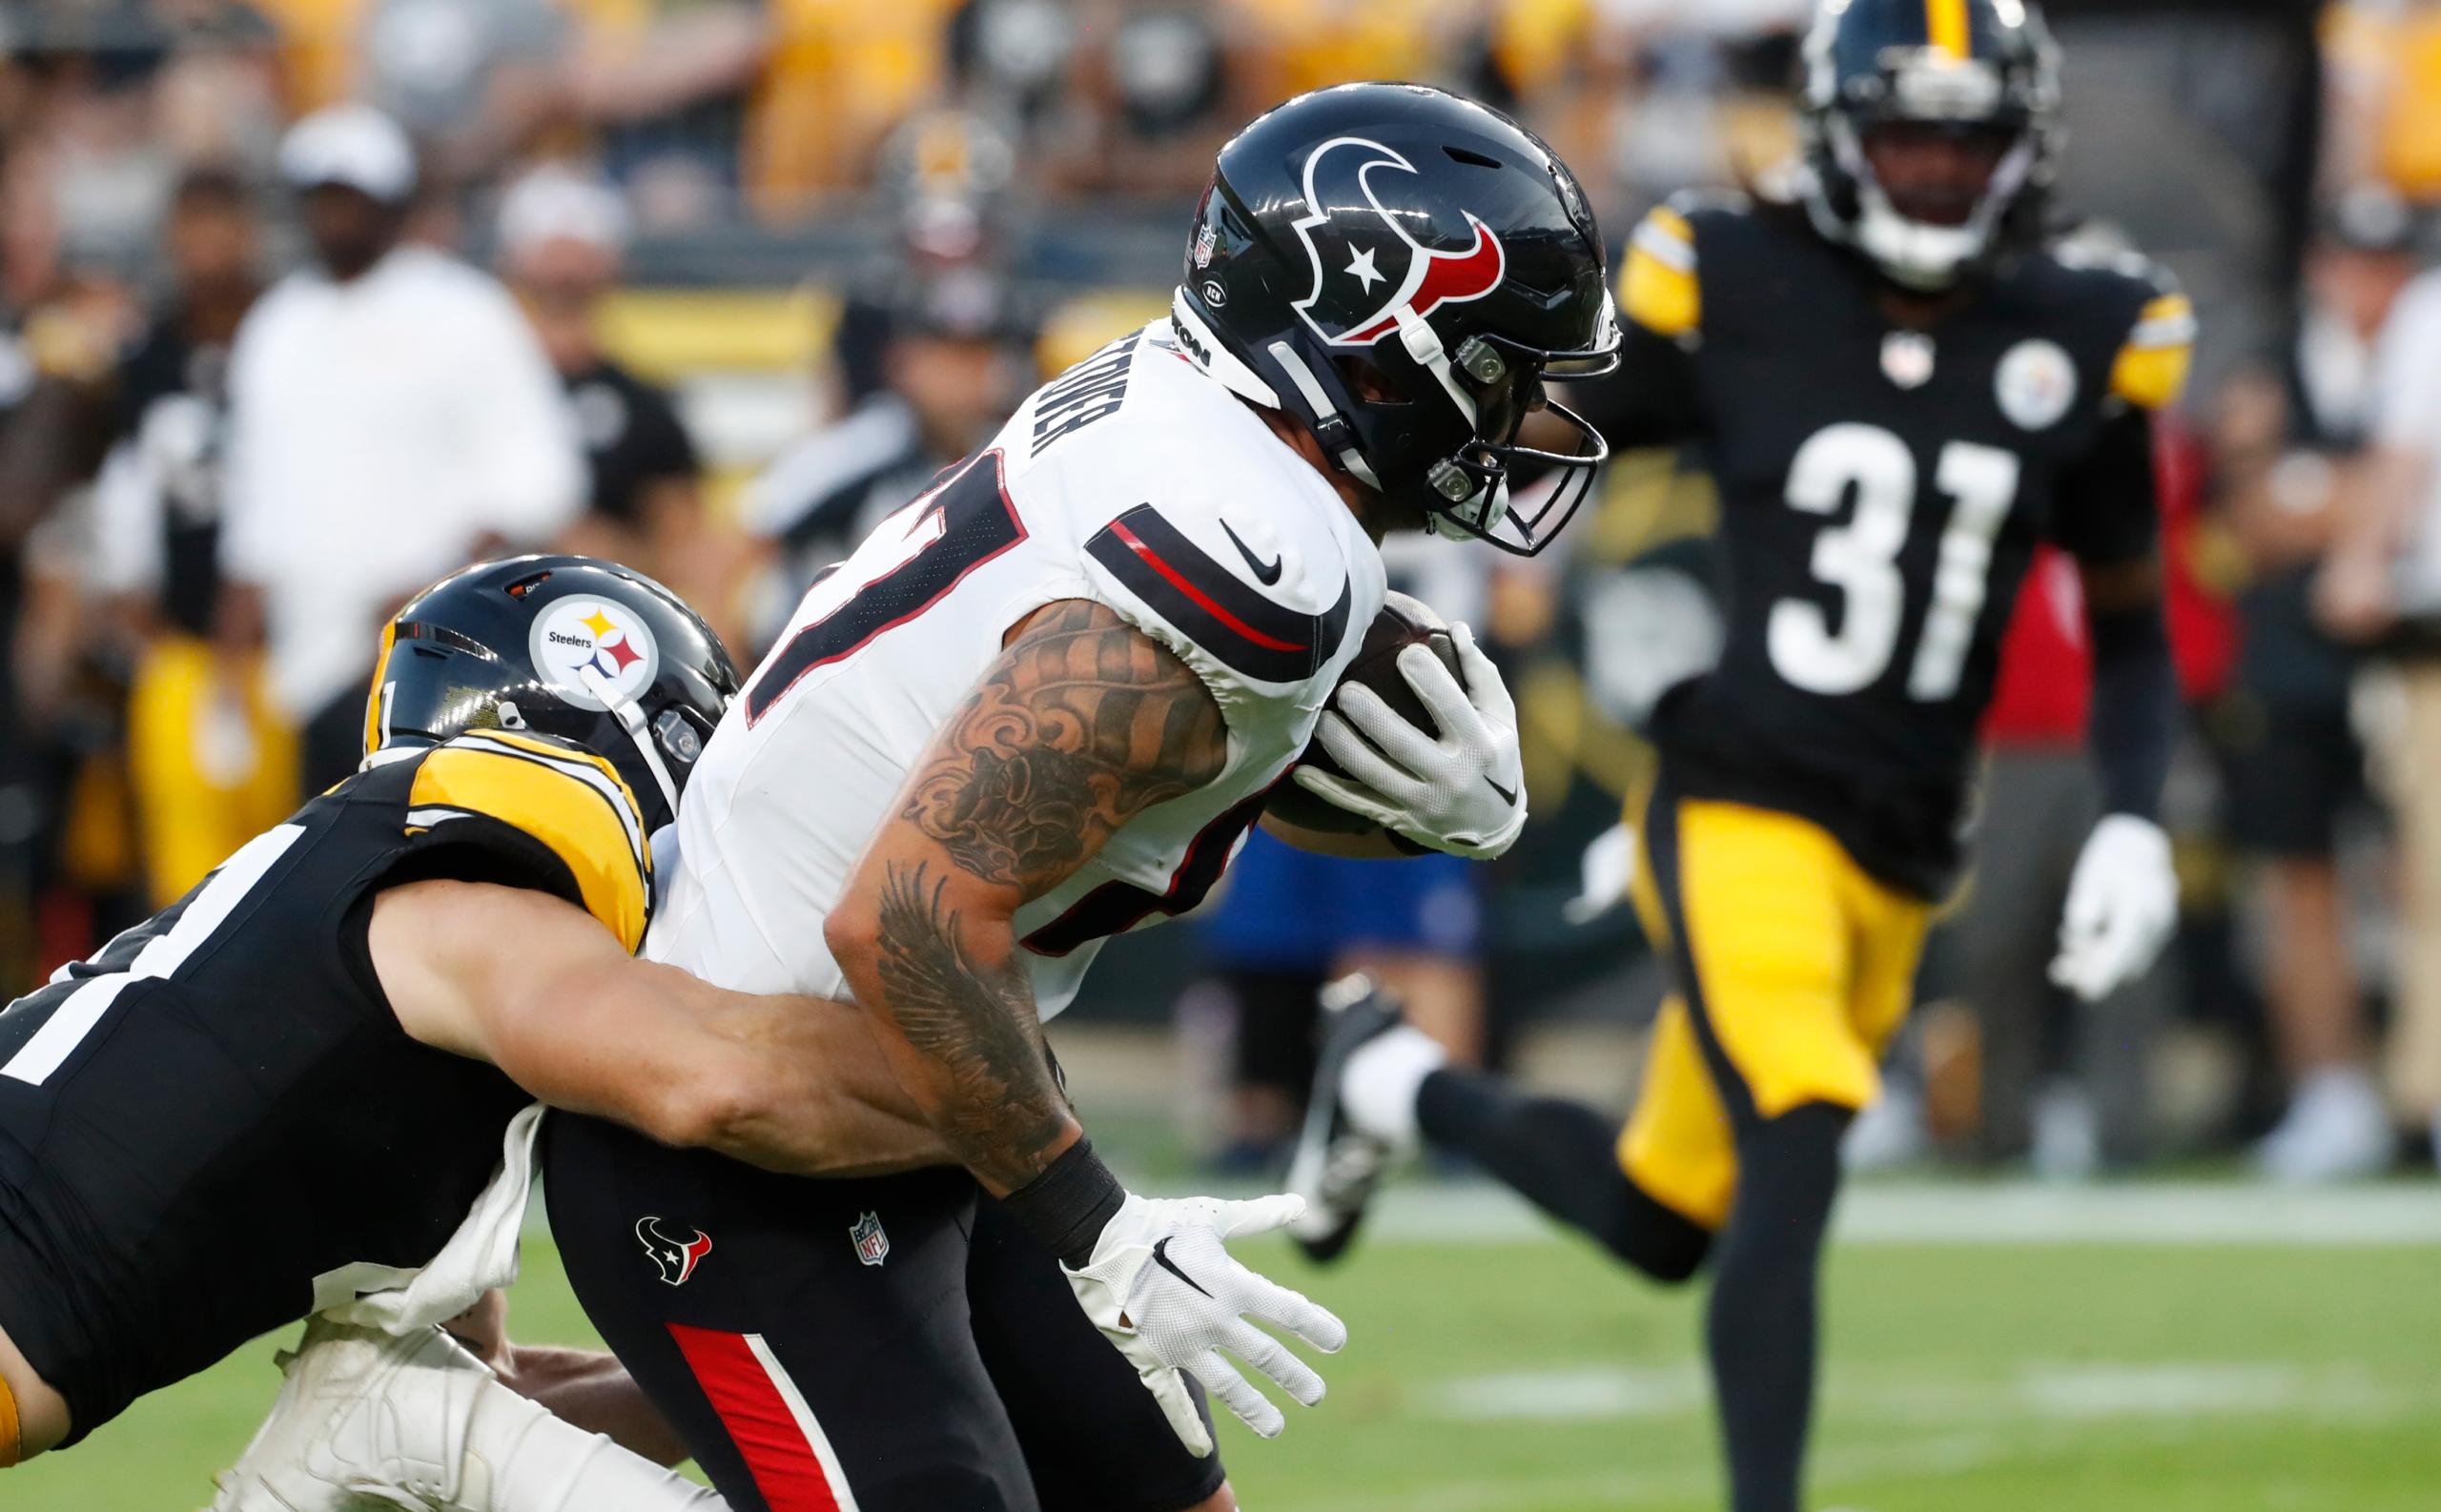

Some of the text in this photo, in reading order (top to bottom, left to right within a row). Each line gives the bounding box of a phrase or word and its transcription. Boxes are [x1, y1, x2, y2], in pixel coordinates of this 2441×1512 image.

[1031, 326, 1146, 460] TOVER
[548, 631, 592, 648] Steelers
[745, 447, 1030, 731] 7
[1767, 421, 2020, 701] 31
[0, 823, 307, 1086] 1
